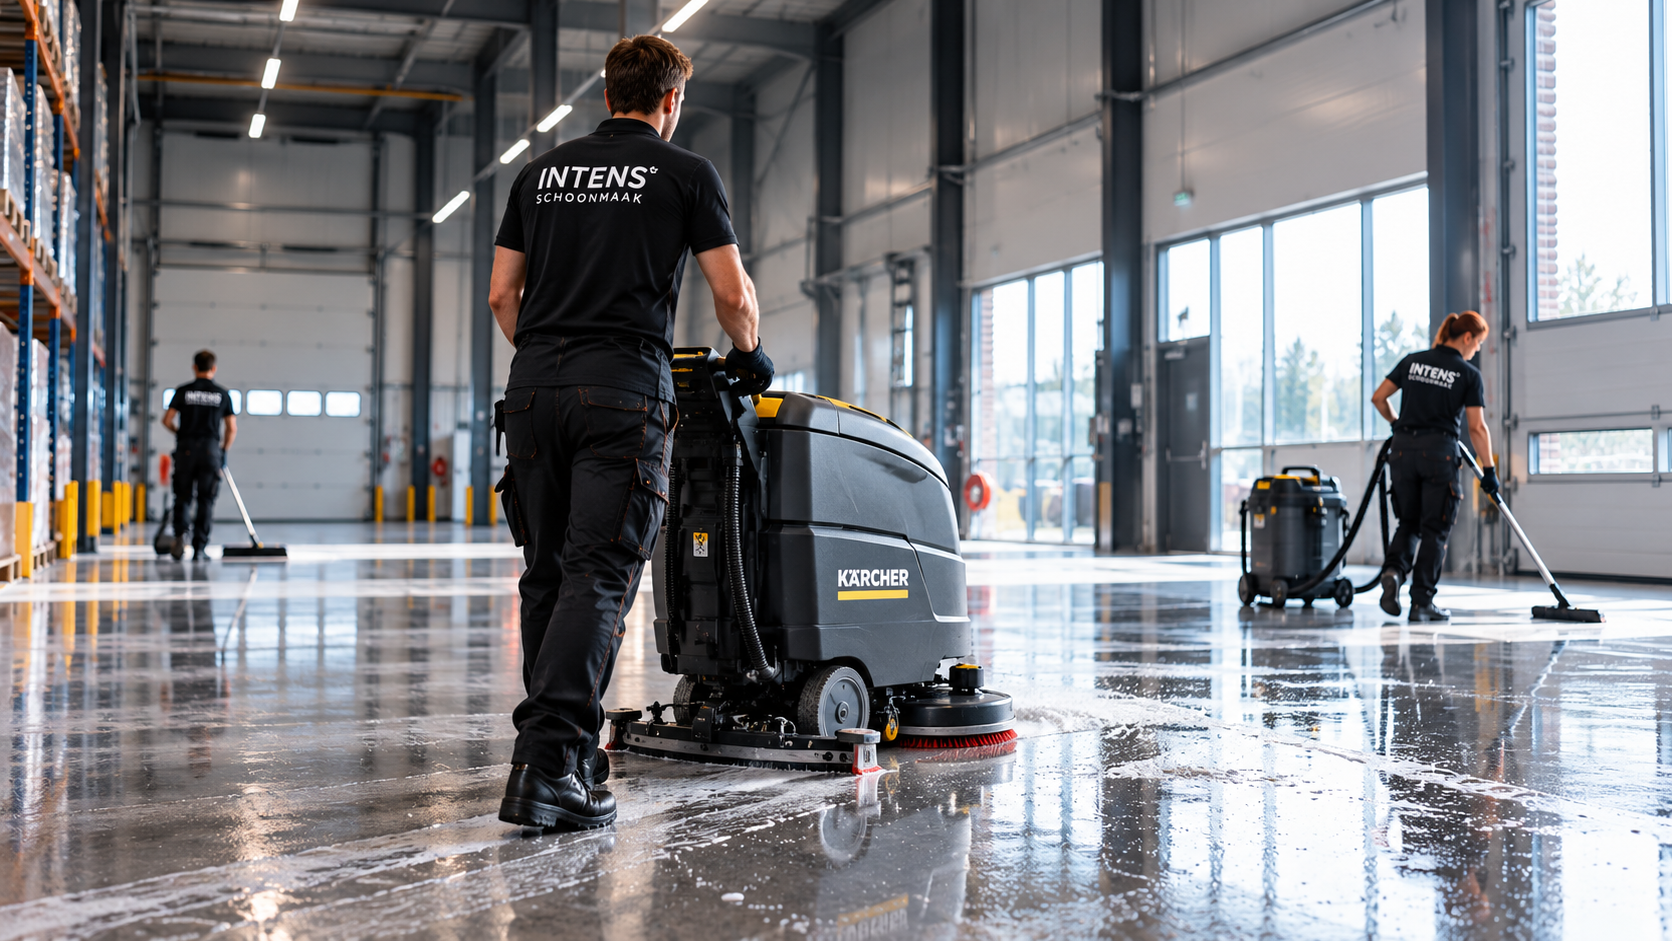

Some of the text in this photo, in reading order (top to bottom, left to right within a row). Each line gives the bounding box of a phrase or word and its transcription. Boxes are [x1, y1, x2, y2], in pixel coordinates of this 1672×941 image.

[538, 166, 648, 189] INTENS
[536, 192, 642, 204] SCHOONMAAK
[1409, 362, 1455, 383] INTENS
[838, 569, 909, 587] KÄRCHER
